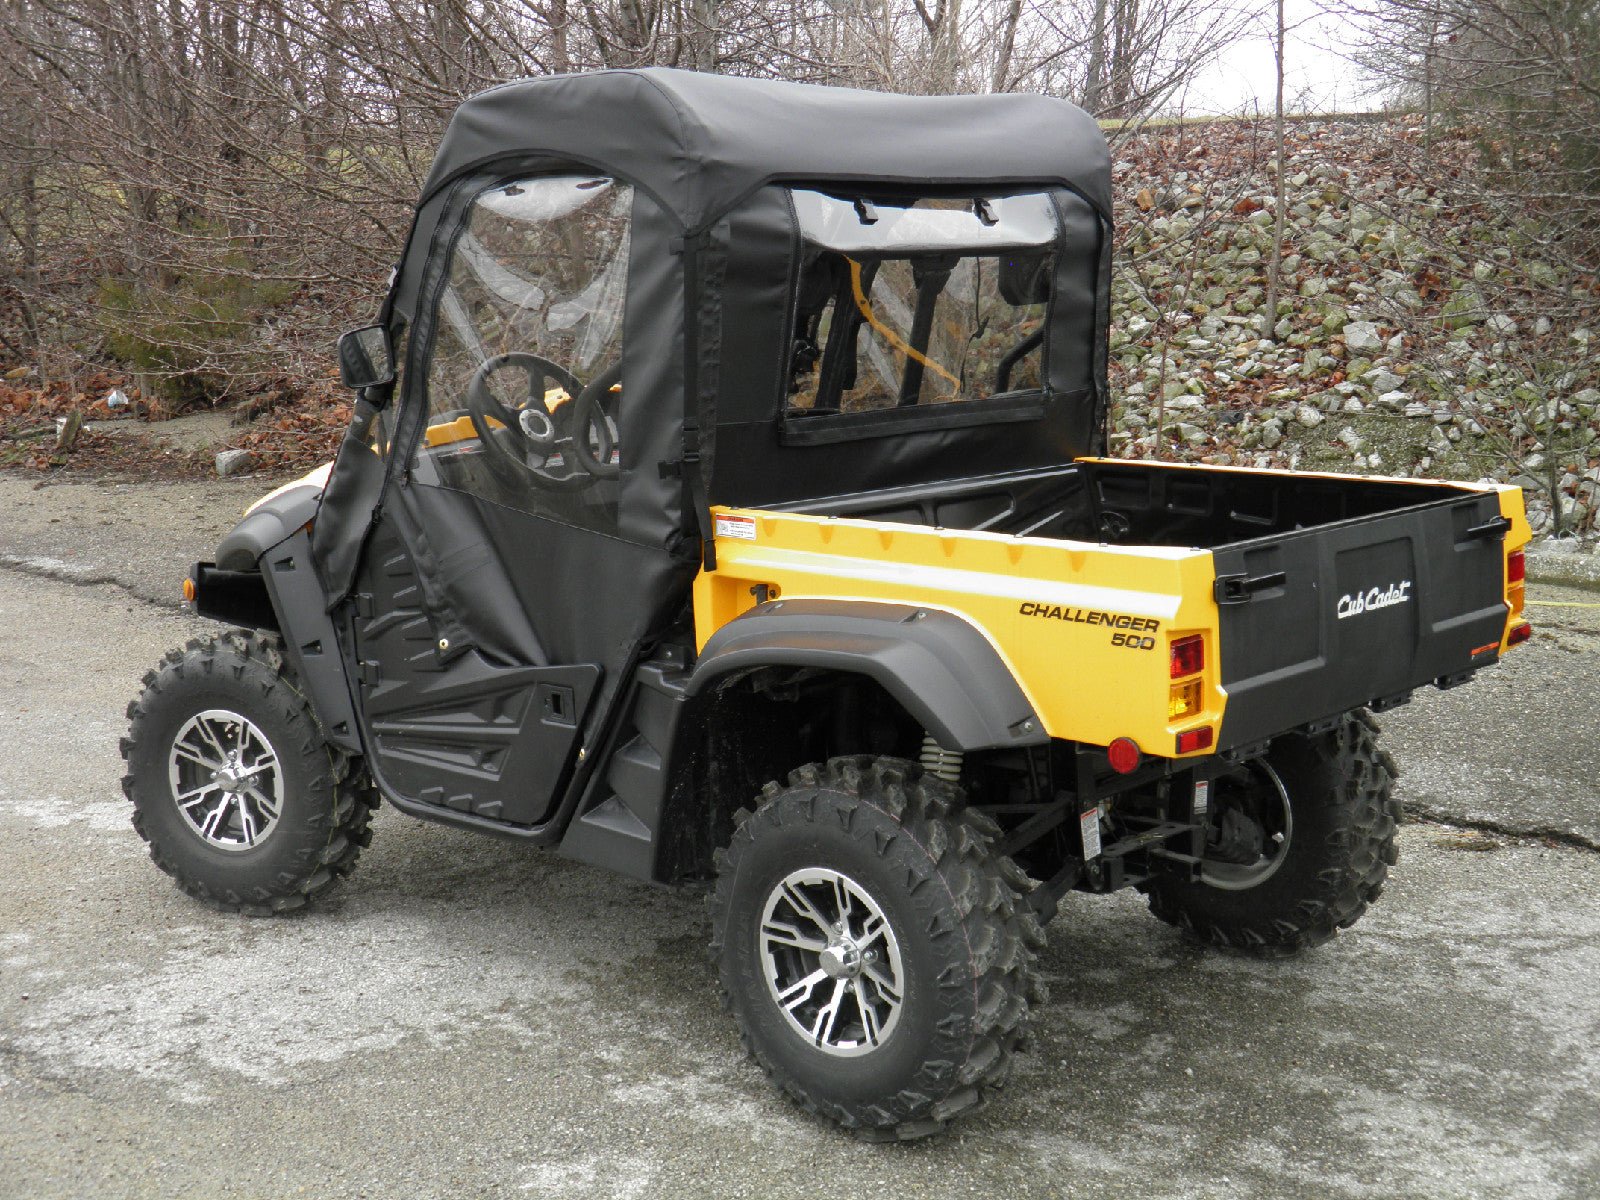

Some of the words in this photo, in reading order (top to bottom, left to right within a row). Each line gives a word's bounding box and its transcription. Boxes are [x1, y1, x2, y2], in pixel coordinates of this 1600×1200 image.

[1337, 591, 1364, 619] Cub
[1365, 580, 1411, 610] Cadet
[1019, 602, 1161, 633] CHALLENGER
[1111, 633, 1156, 650] 500
